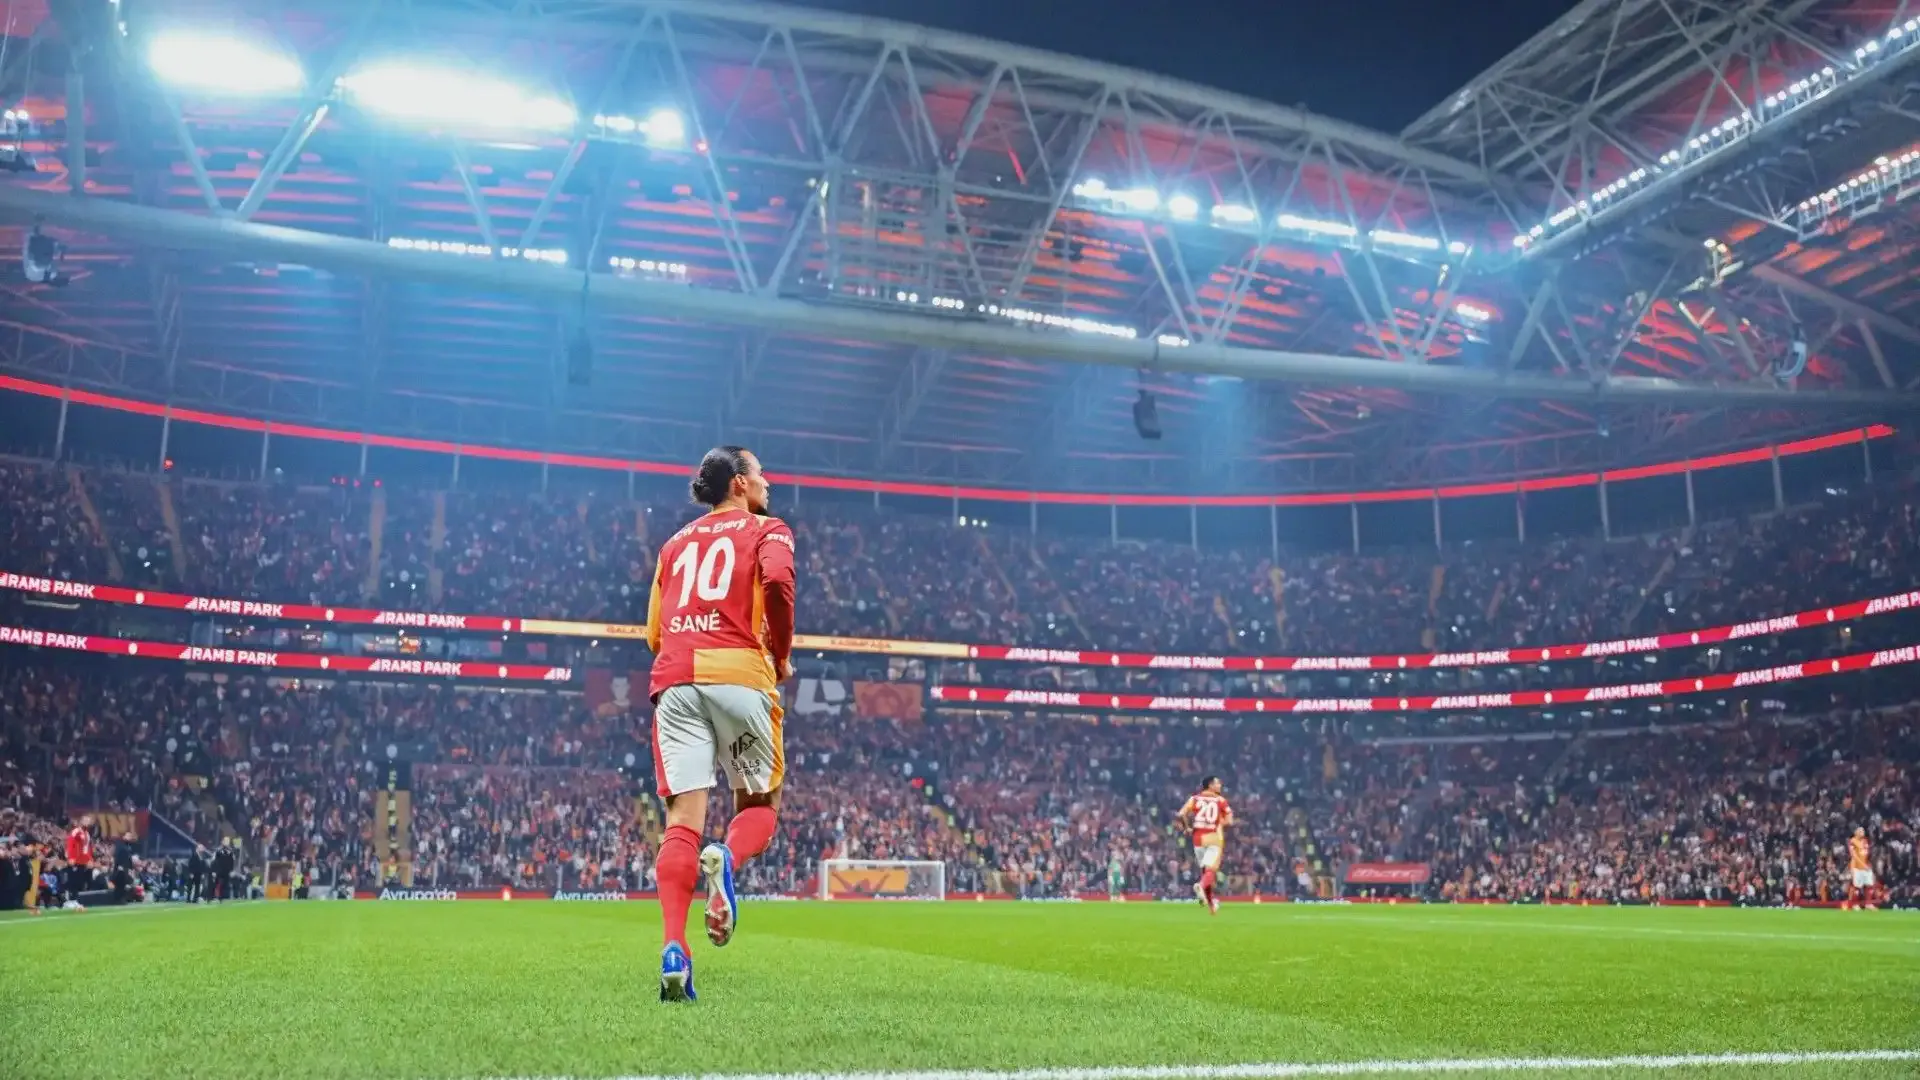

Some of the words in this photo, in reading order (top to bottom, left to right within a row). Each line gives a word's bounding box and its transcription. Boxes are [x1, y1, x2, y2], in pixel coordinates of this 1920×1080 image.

[672, 536, 735, 609] 10
[8, 573, 51, 593] RAMS
[53, 581, 96, 598] PARK
[199, 597, 240, 614] RAMS
[243, 602, 283, 617] PARK
[1874, 593, 1909, 612] RAMS
[385, 611, 426, 626] RAMS
[427, 614, 466, 628] PARK
[669, 609, 721, 633] SANÉ
[1739, 620, 1768, 636] RAMS
[1769, 614, 1798, 632] PARK
[0, 626, 43, 646] RAMS
[45, 632, 88, 650] PARK
[1591, 640, 1626, 656] RAMS
[1627, 636, 1659, 652] PARK
[192, 647, 235, 663] RAMS
[237, 650, 278, 666] PARK
[1014, 647, 1048, 661] RAMS
[1049, 649, 1080, 663] PARK
[1159, 655, 1191, 668] RAMS
[1192, 656, 1225, 669] PARK
[1301, 656, 1337, 669] RAMS
[1338, 656, 1371, 669] PARK
[1440, 653, 1475, 666] RAMS
[1476, 650, 1510, 664] PARK
[1880, 646, 1915, 664] RAMS
[381, 659, 422, 674] RAMS
[423, 661, 462, 676] PARK
[1741, 669, 1773, 684] RAMS
[1774, 664, 1804, 680] PARK
[1014, 690, 1048, 703] RAMS
[1049, 691, 1080, 705] PARK
[1594, 685, 1629, 700] RAMS
[1630, 681, 1663, 697] PARK
[1159, 697, 1192, 710] RAMS
[1193, 698, 1225, 710] PARK
[1302, 698, 1338, 711] RAMS
[1339, 698, 1373, 711] PARK
[1441, 696, 1477, 708] RAMS
[1479, 693, 1512, 706] PARK
[1194, 801, 1219, 824] 20
